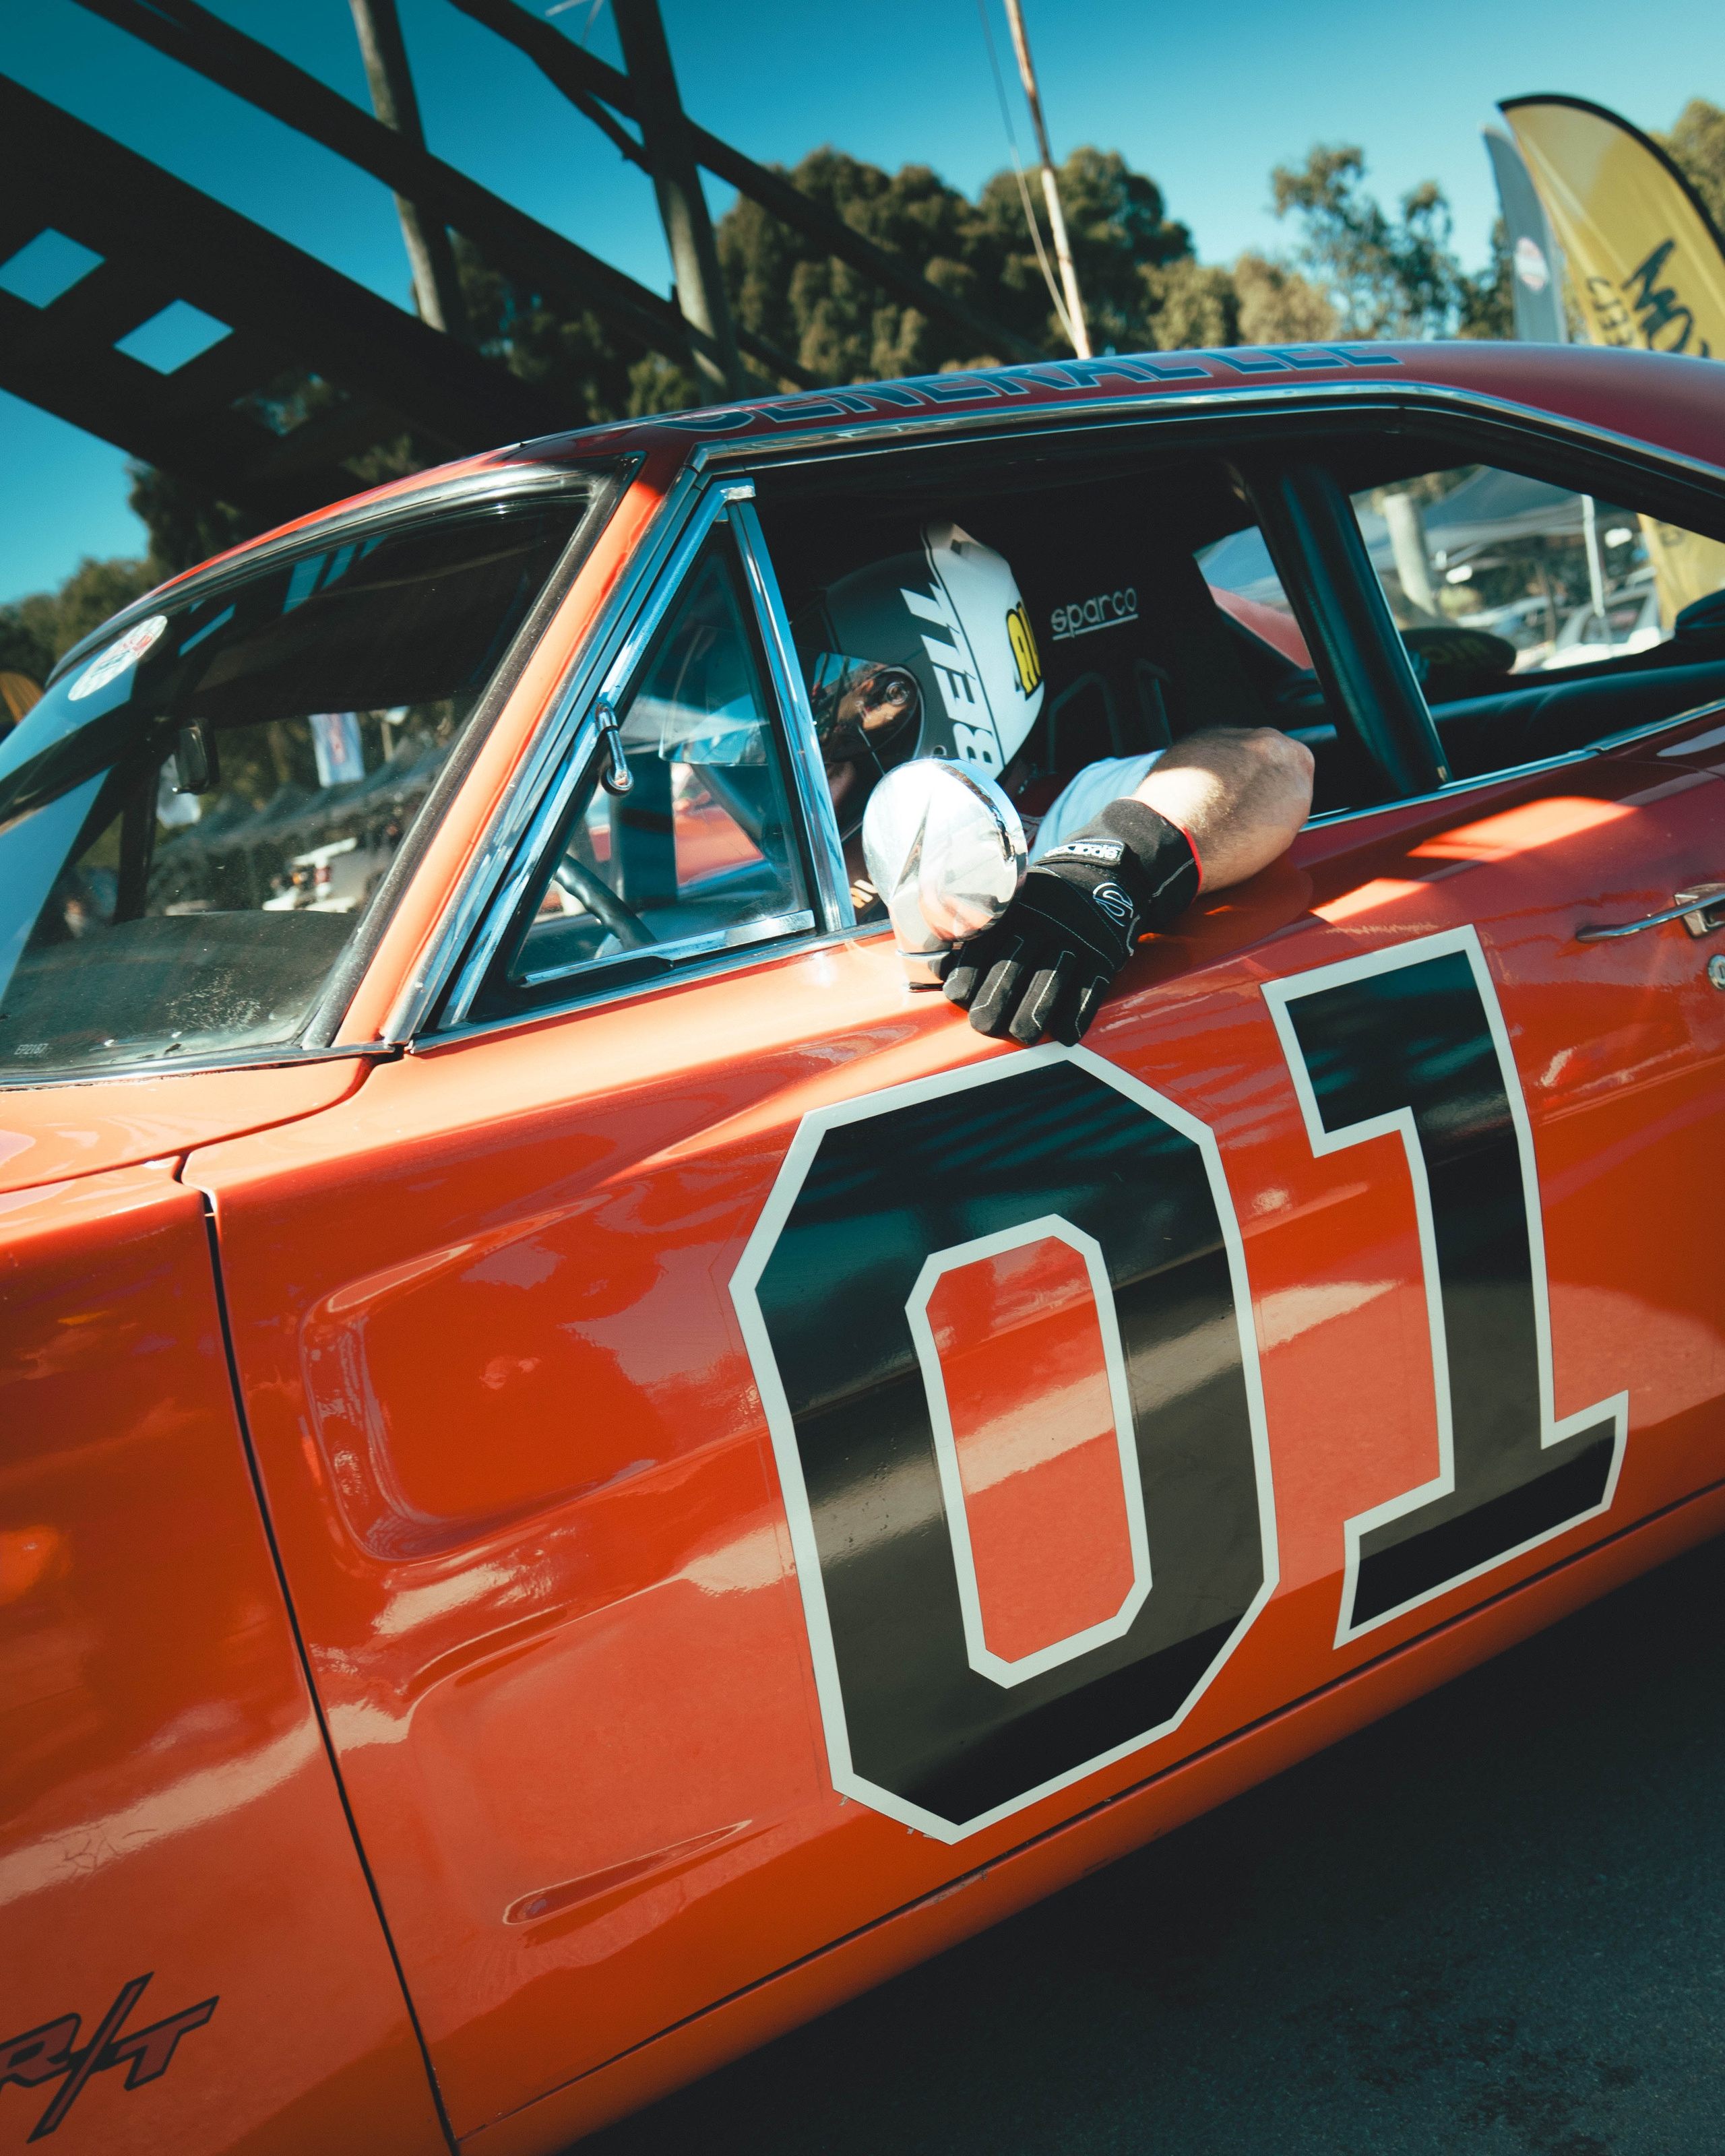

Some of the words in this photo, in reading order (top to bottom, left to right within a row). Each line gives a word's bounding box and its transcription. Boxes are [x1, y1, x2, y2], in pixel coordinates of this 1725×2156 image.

[648, 356, 1212, 433] GENERAL
[1189, 343, 1404, 374] LEE
[900, 581, 1000, 769] BELL
[1050, 587, 1138, 638] sparco
[728, 924, 1629, 1845] 01
[0, 1971, 220, 2144] R/T
